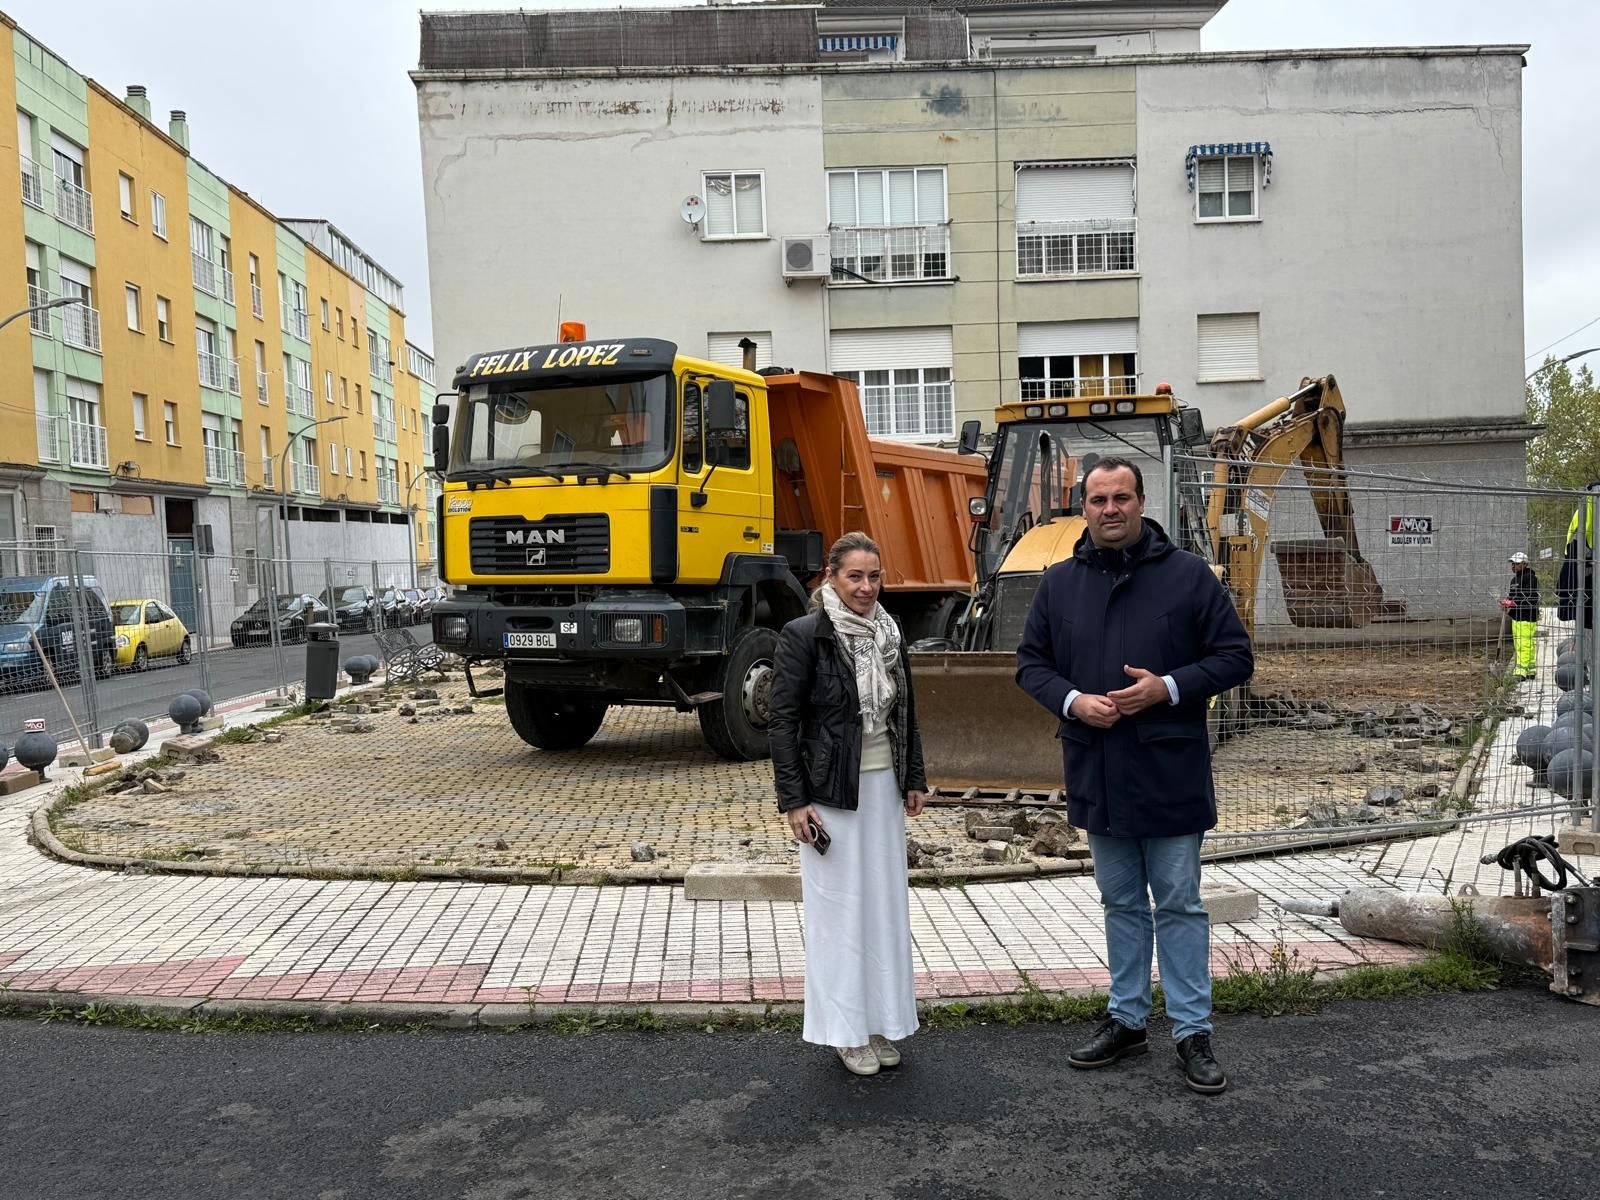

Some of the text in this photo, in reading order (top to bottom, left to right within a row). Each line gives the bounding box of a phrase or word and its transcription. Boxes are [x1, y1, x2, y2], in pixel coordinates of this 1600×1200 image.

[470, 344, 625, 377] FELIX LOPEZ
[506, 529, 565, 545] MAN
[562, 623, 576, 633] SP
[509, 634, 555, 647] 0929 BGL
